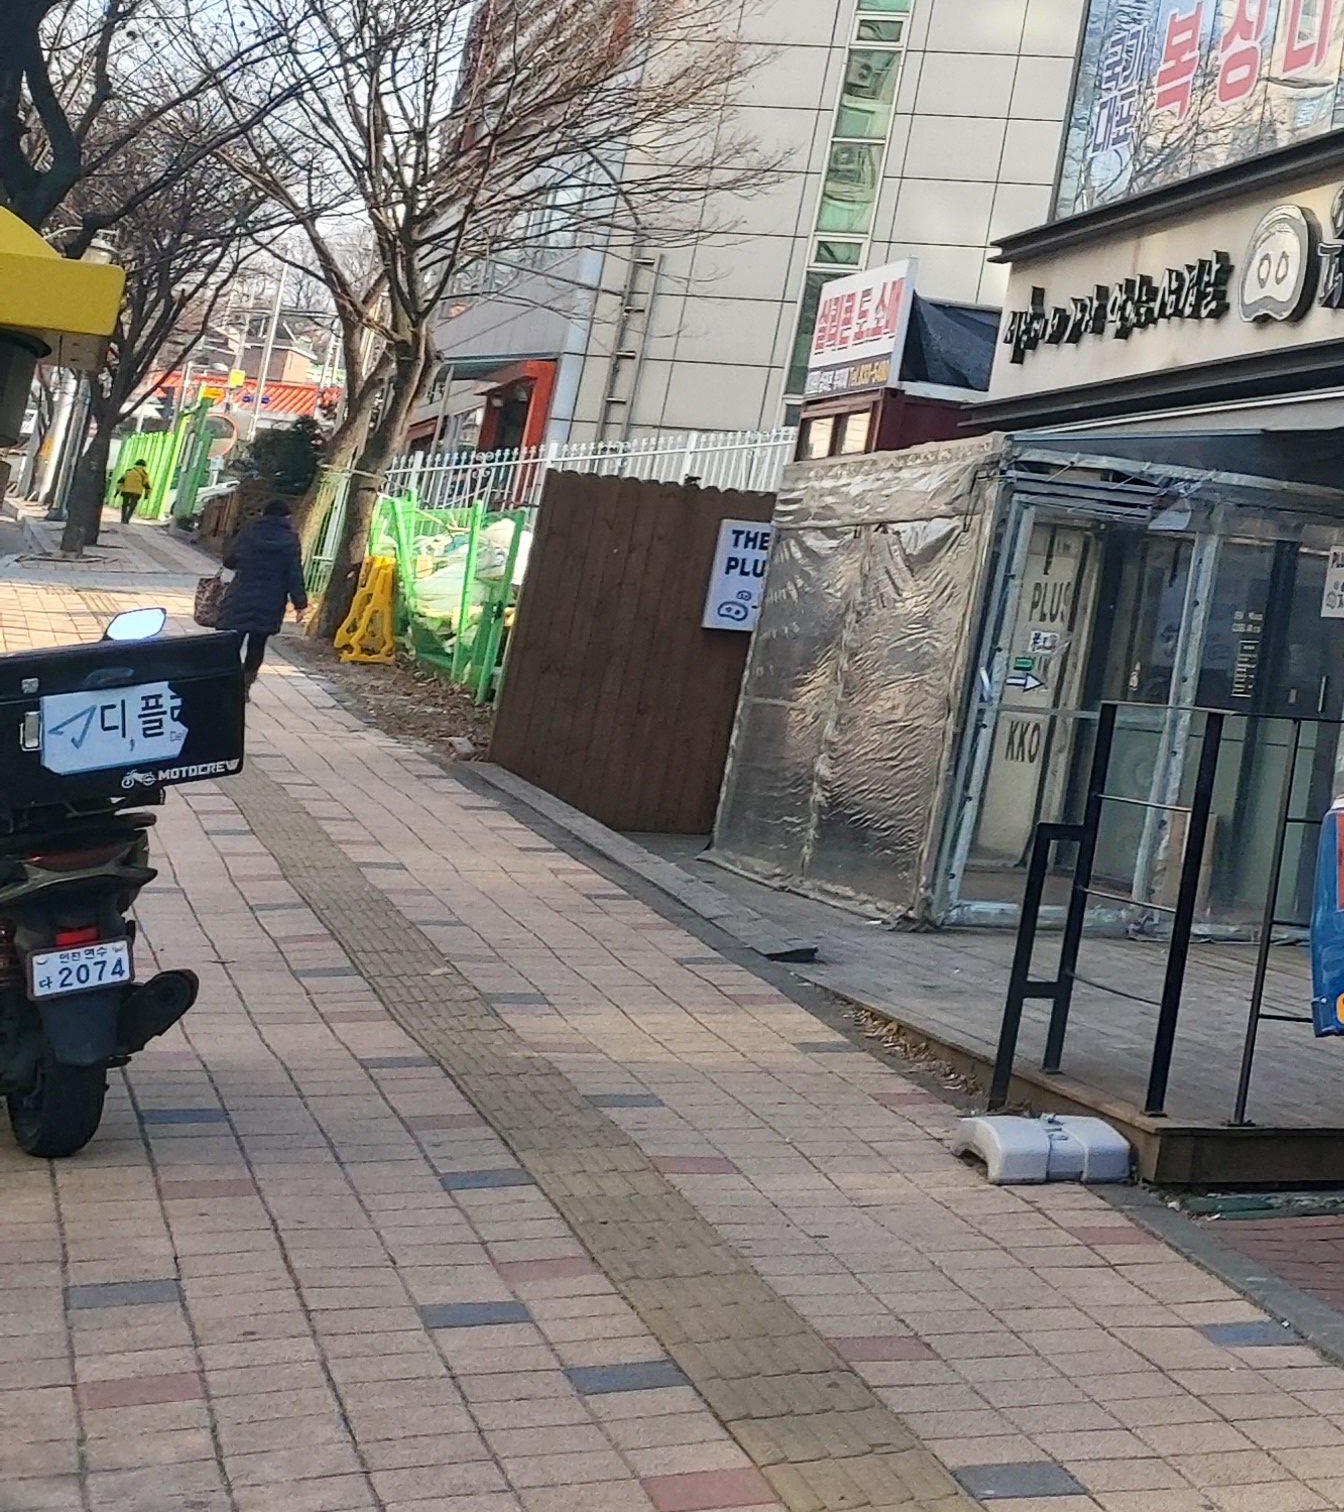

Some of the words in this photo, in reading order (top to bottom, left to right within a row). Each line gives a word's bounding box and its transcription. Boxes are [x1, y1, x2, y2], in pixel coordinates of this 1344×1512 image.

[731, 529, 772, 551] THE
[724, 556, 767, 578] PLU
[1004, 719, 1042, 765] KKO
[157, 758, 240, 781] MOTOCREW
[59, 951, 82, 964] 인천
[84, 947, 107, 960] 연수
[39, 976, 53, 989] 다
[58, 957, 125, 989] 2074
